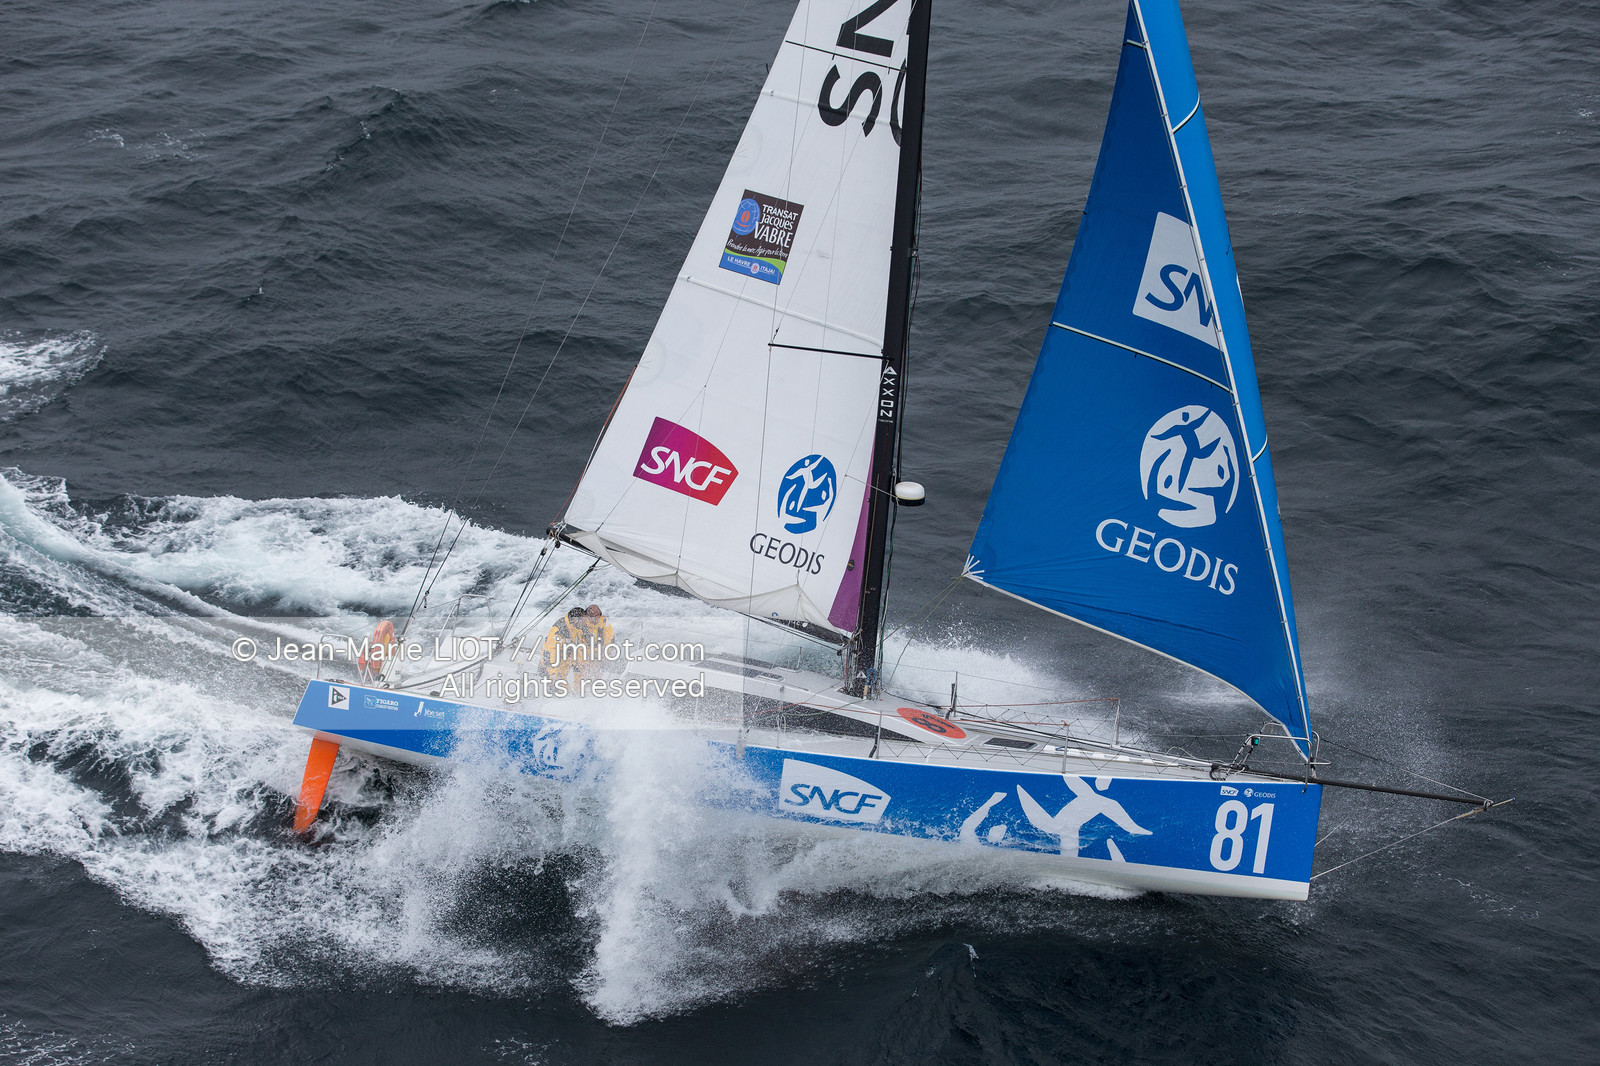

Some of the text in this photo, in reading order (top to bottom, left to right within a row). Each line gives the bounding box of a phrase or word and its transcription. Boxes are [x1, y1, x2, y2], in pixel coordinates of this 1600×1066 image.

[758, 213, 794, 231] Jacques
[762, 204, 799, 221] TRANSAT
[754, 221, 793, 248] VABRE
[734, 258, 751, 267] HAVRE
[881, 366, 897, 418] AXXON
[640, 446, 732, 491] SNCF
[749, 532, 825, 575] GEODIS
[1095, 518, 1239, 595] GEODIS
[376, 698, 399, 707] FIGARO
[784, 783, 883, 815] SNCF
[1221, 787, 1276, 799] SNCF GEODIS
[1209, 800, 1275, 874] 81
